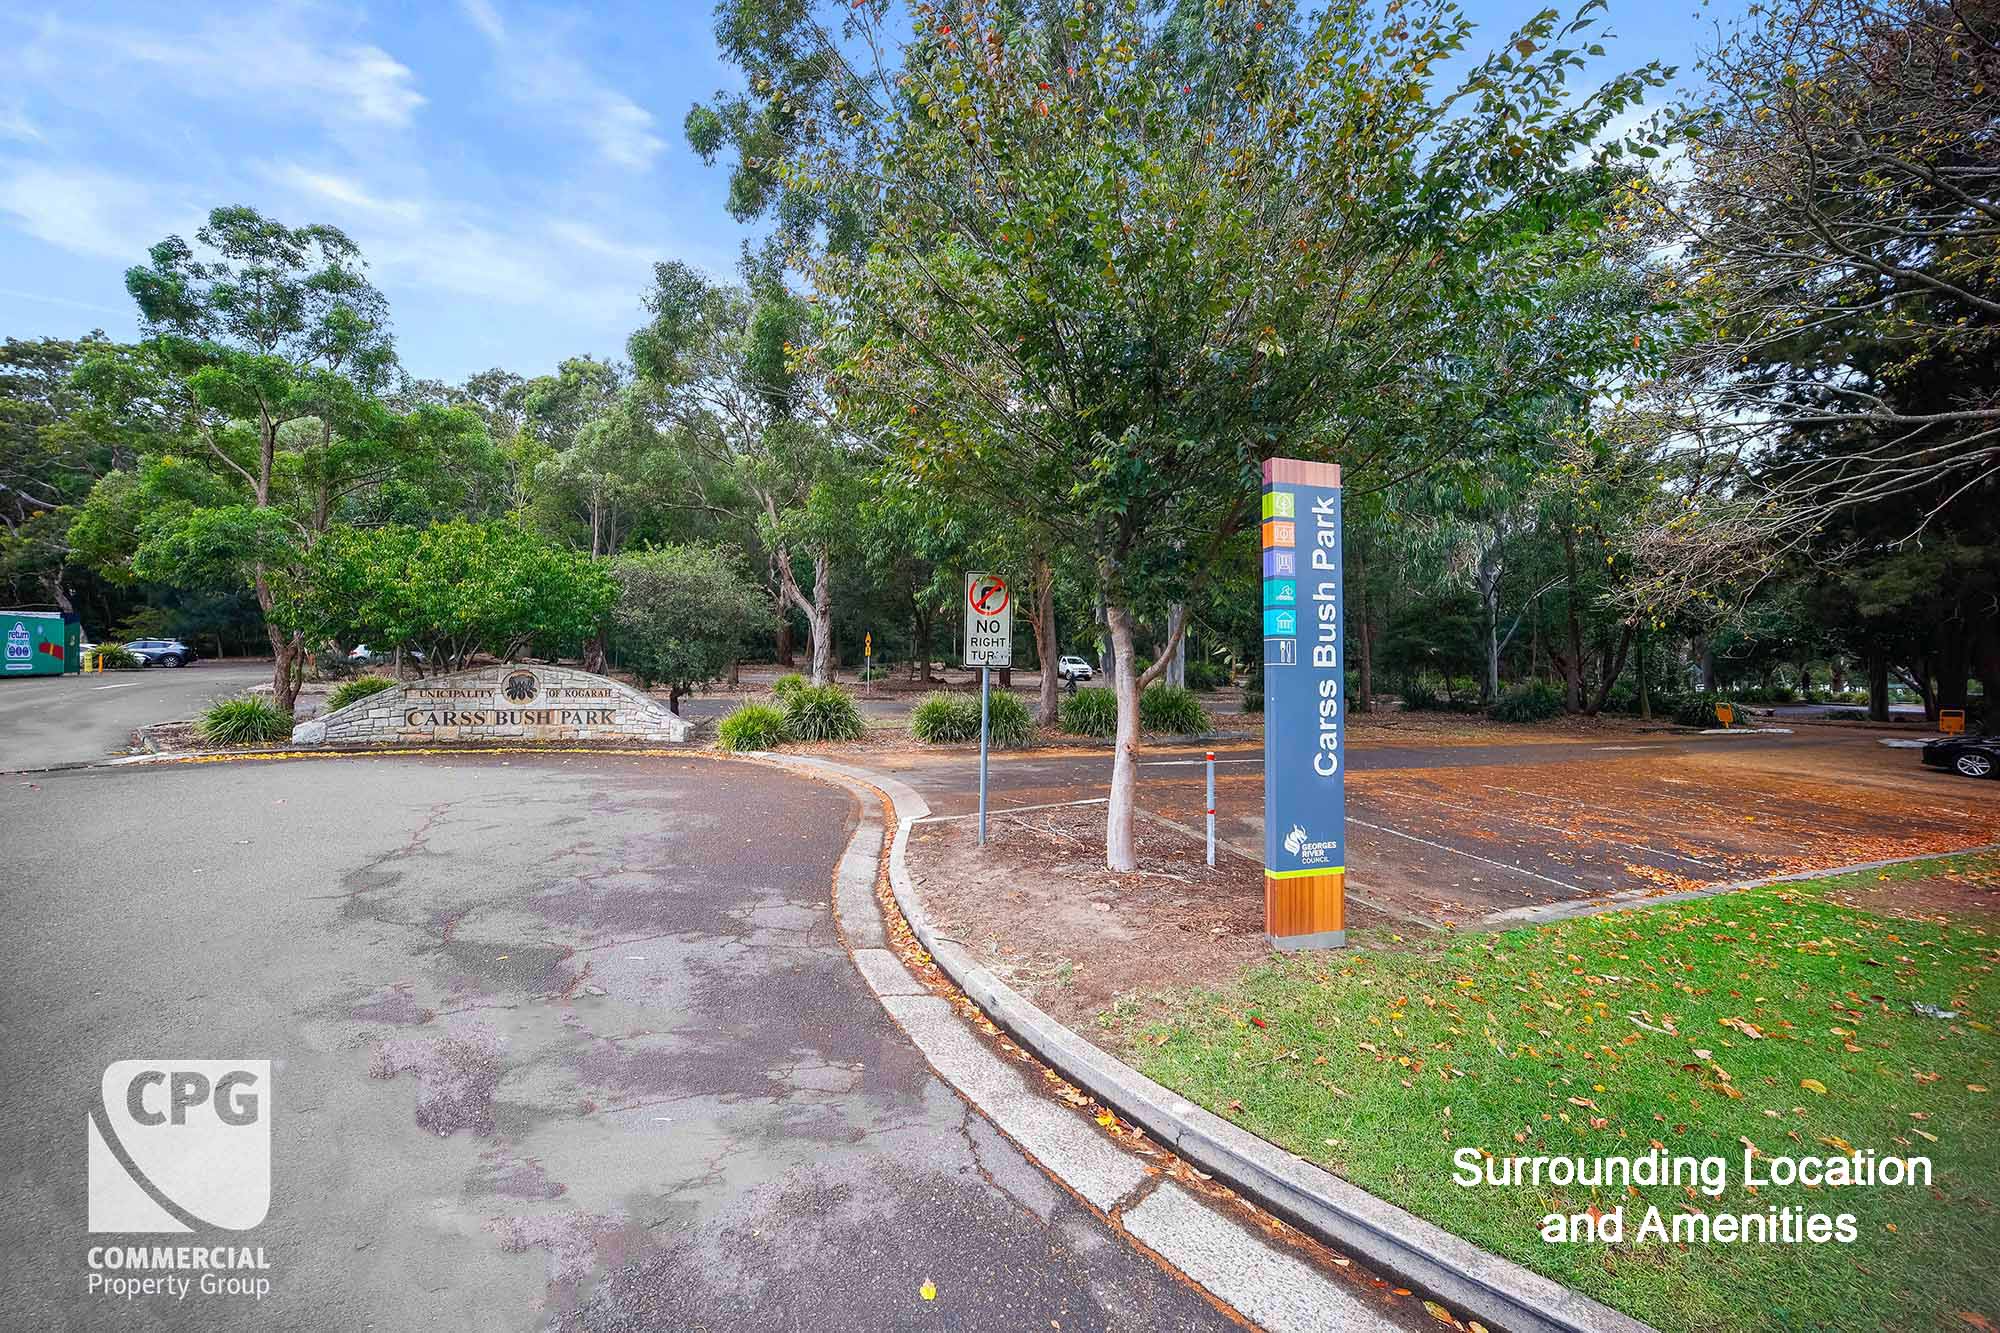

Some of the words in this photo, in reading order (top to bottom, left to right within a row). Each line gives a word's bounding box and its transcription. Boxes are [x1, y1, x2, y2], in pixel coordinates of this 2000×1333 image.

[1312, 496, 1336, 570] Park
[976, 620, 1000, 633] NO
[1312, 583, 1337, 667] Bush
[970, 637, 1006, 648] RIGHT
[970, 651, 1003, 661] TUR
[407, 710, 486, 726] CARSS
[495, 710, 550, 725] BUSH
[560, 710, 616, 725] PARK
[1313, 679, 1338, 777] Carss
[1301, 841, 1337, 851] GEORGES
[1301, 850, 1325, 858] RIVER
[1301, 856, 1330, 864] COUNCIL
